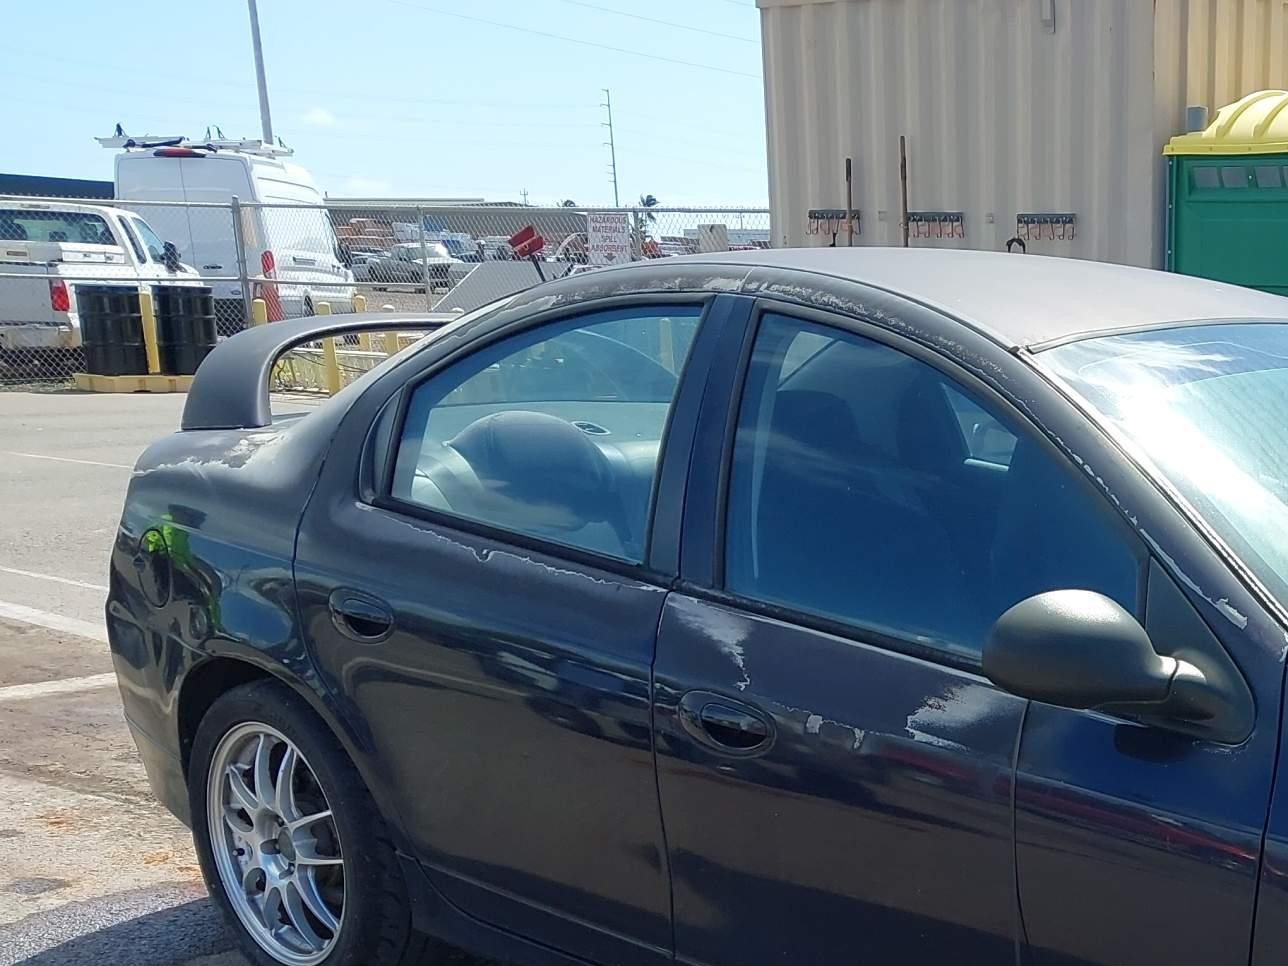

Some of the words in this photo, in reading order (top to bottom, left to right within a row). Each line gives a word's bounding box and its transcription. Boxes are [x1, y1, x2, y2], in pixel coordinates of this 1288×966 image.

[590, 216, 626, 224] HAZARDOUS
[592, 225, 625, 233] MATERIALS
[601, 235, 617, 243] SPILL
